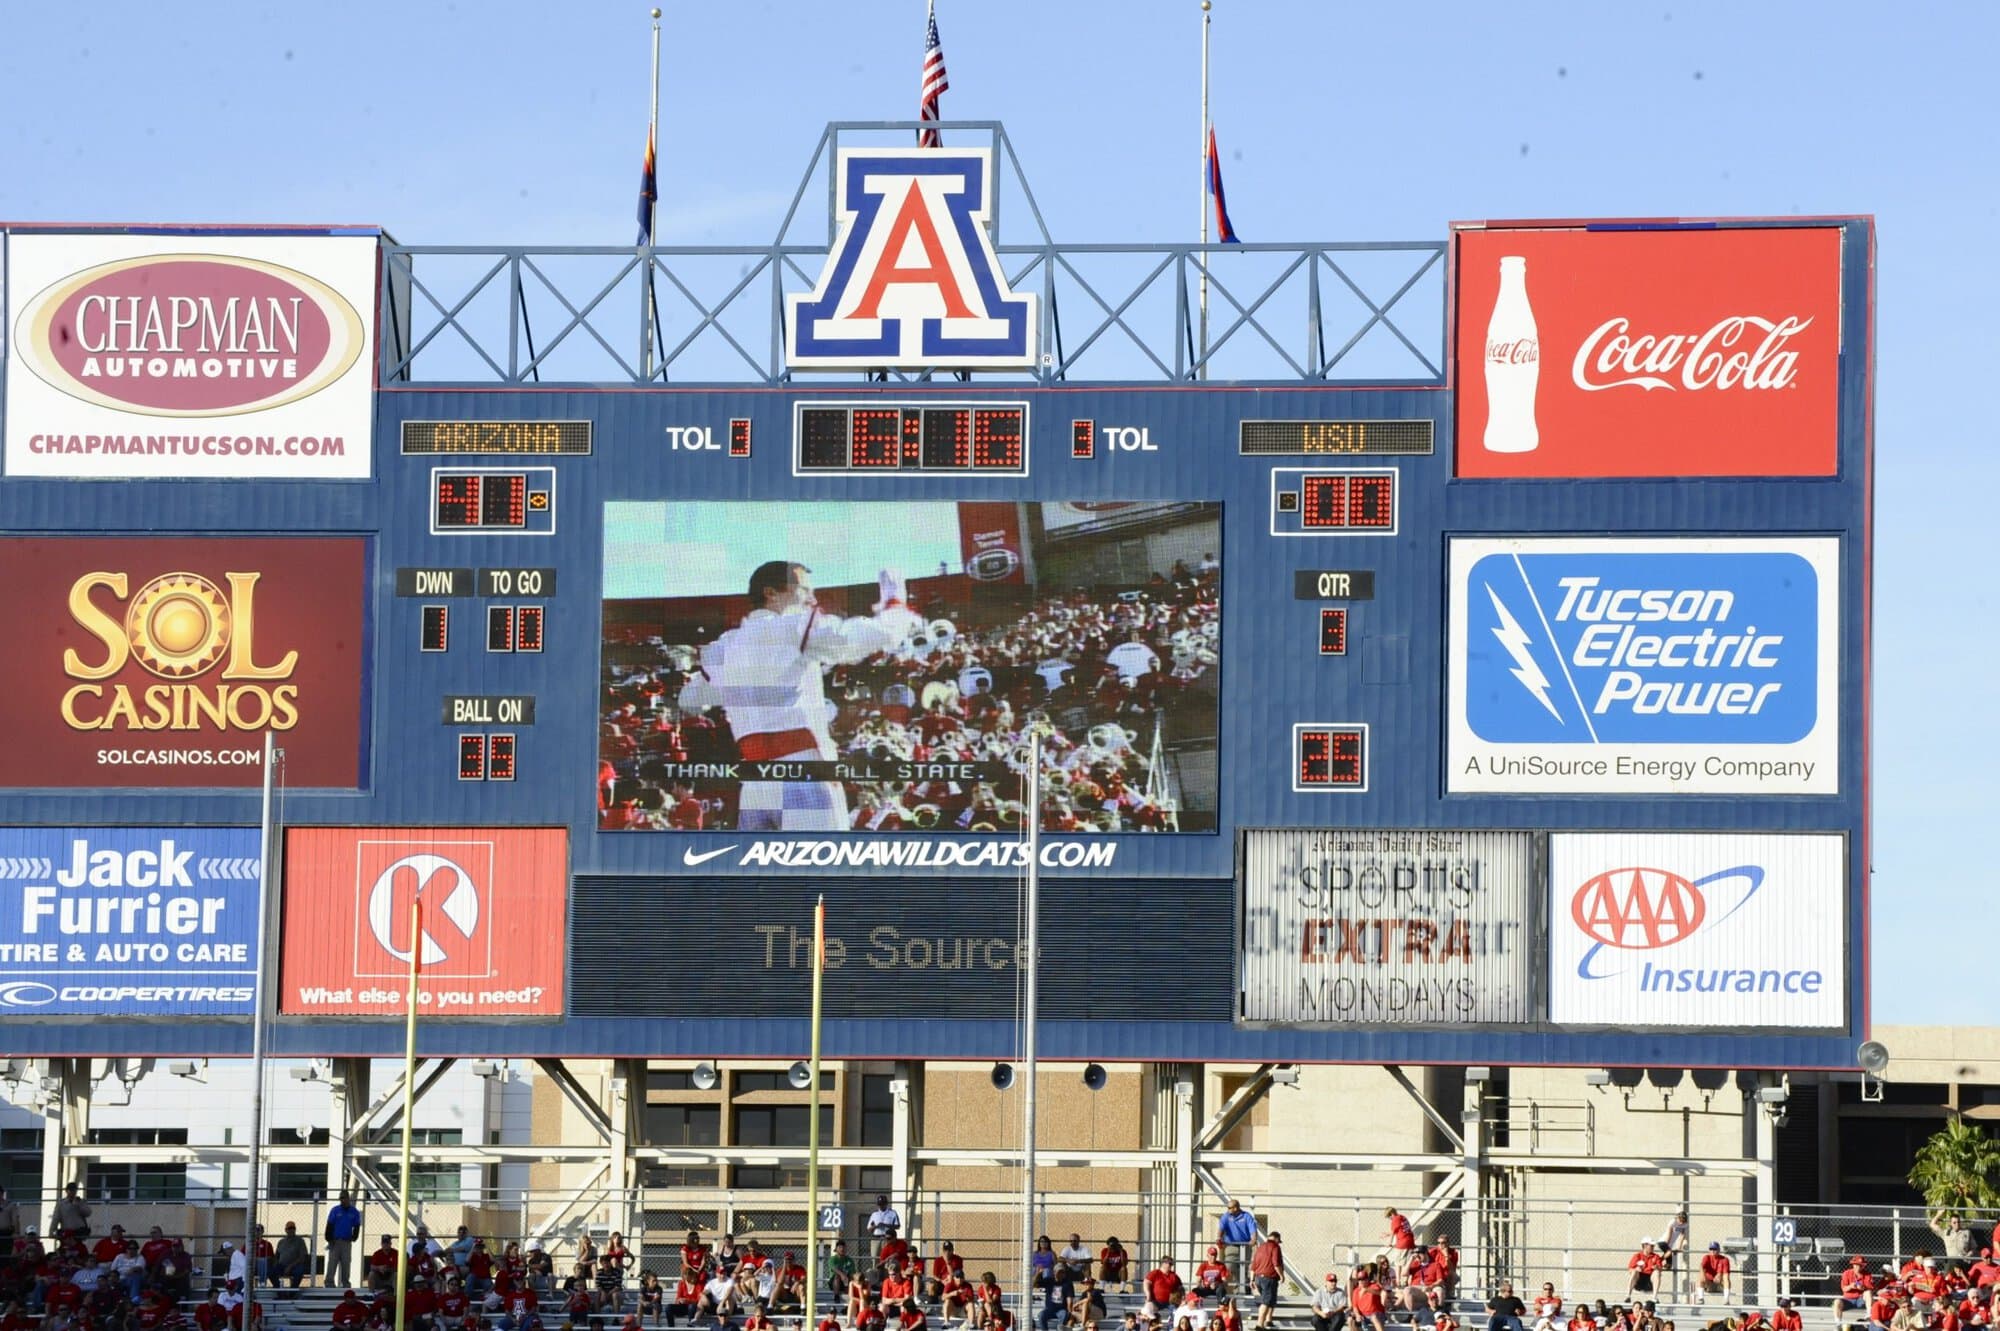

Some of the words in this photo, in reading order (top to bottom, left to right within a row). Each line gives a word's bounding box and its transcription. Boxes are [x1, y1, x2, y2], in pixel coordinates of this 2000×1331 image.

[790, 150, 1032, 362] A
[75, 294, 303, 354] CHAPMAN
[82, 357, 297, 378] AUTOMOTIVE
[1488, 338, 1538, 364] oca-Cola
[1572, 315, 1815, 392] Coca-Cola
[29, 434, 346, 457] CHAPMANTUCSON.COM
[434, 423, 561, 453] ARIZONA
[666, 426, 722, 451] TOL
[731, 421, 749, 456] 3
[851, 410, 1021, 466] 6:16
[1072, 422, 1091, 456] 3
[1103, 427, 1159, 452] TOL
[1303, 424, 1365, 453] WSU
[439, 476, 524, 525] 41
[1304, 478, 1391, 526] 00
[415, 571, 453, 595] DWN
[491, 571, 512, 594] TO
[518, 571, 542, 594] GO
[1318, 573, 1350, 597] QTR
[1555, 577, 1735, 622] Tucson
[63, 571, 299, 681] SOL
[504, 608, 542, 649] 10
[1320, 610, 1345, 650] 3
[1573, 624, 1784, 667] Electric
[61, 685, 299, 732] CASINOS
[453, 699, 493, 722] BALL
[498, 699, 522, 722] ON
[1593, 671, 1782, 715] Power
[97, 749, 261, 766] SOLCASINOS.COM
[461, 736, 513, 777] 35
[664, 763, 740, 779] THANK
[757, 763, 812, 782] YOU,
[835, 763, 880, 779] ALL
[898, 763, 985, 779] STATE.
[1301, 733, 1360, 780] 25
[1465, 757, 1482, 775] A
[1490, 756, 1608, 776] UniSource
[1617, 757, 1697, 781] Energy
[1704, 756, 1815, 781] Company
[56, 839, 196, 888] Jack
[739, 840, 1117, 867] ARIZONAWILDCATSCOM
[1298, 865, 1474, 909] SPORTS
[23, 886, 226, 935] Furrier
[1578, 868, 1701, 946] AAA
[0, 943, 59, 963] TIRE
[66, 943, 87, 963] &
[95, 943, 169, 963] AUTO
[177, 943, 248, 963] CARE
[754, 924, 847, 969] The
[866, 924, 1042, 969] Source
[1300, 918, 1474, 964] EXTRA
[1301, 976, 1475, 1012] MONDAYS
[1640, 961, 1824, 994] Insurance
[299, 987, 353, 1004] What
[358, 987, 401, 1004] else
[437, 989, 474, 1008] you
[479, 986, 544, 1004] need?
[823, 1206, 842, 1229] 28
[1774, 1220, 1795, 1244] 29
